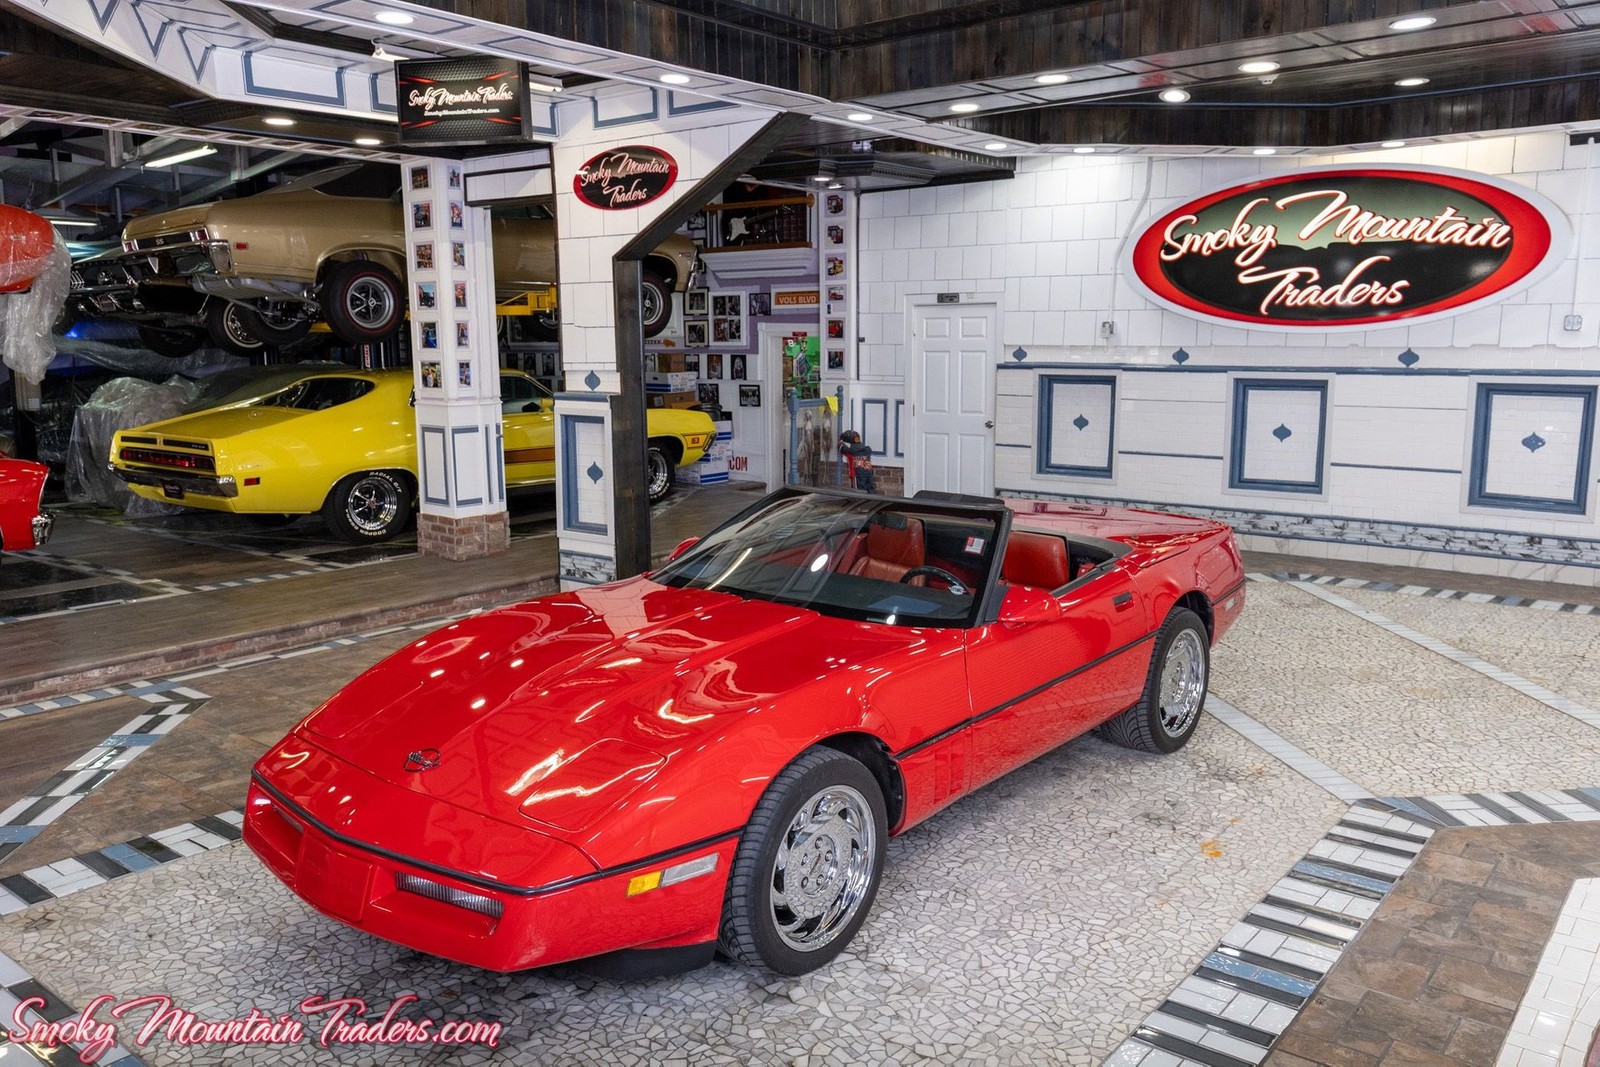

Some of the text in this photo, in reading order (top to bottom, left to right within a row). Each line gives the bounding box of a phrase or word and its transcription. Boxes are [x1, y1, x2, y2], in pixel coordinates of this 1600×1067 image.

[409, 87, 436, 110] Smoky
[432, 87, 481, 106] Mountain
[580, 152, 670, 187] Smoky Mountain
[602, 178, 648, 208] Traders
[1160, 188, 1514, 267] Smoky Mountain
[778, 295, 817, 304] VOLS BLVD
[1236, 255, 1411, 316] Traders
